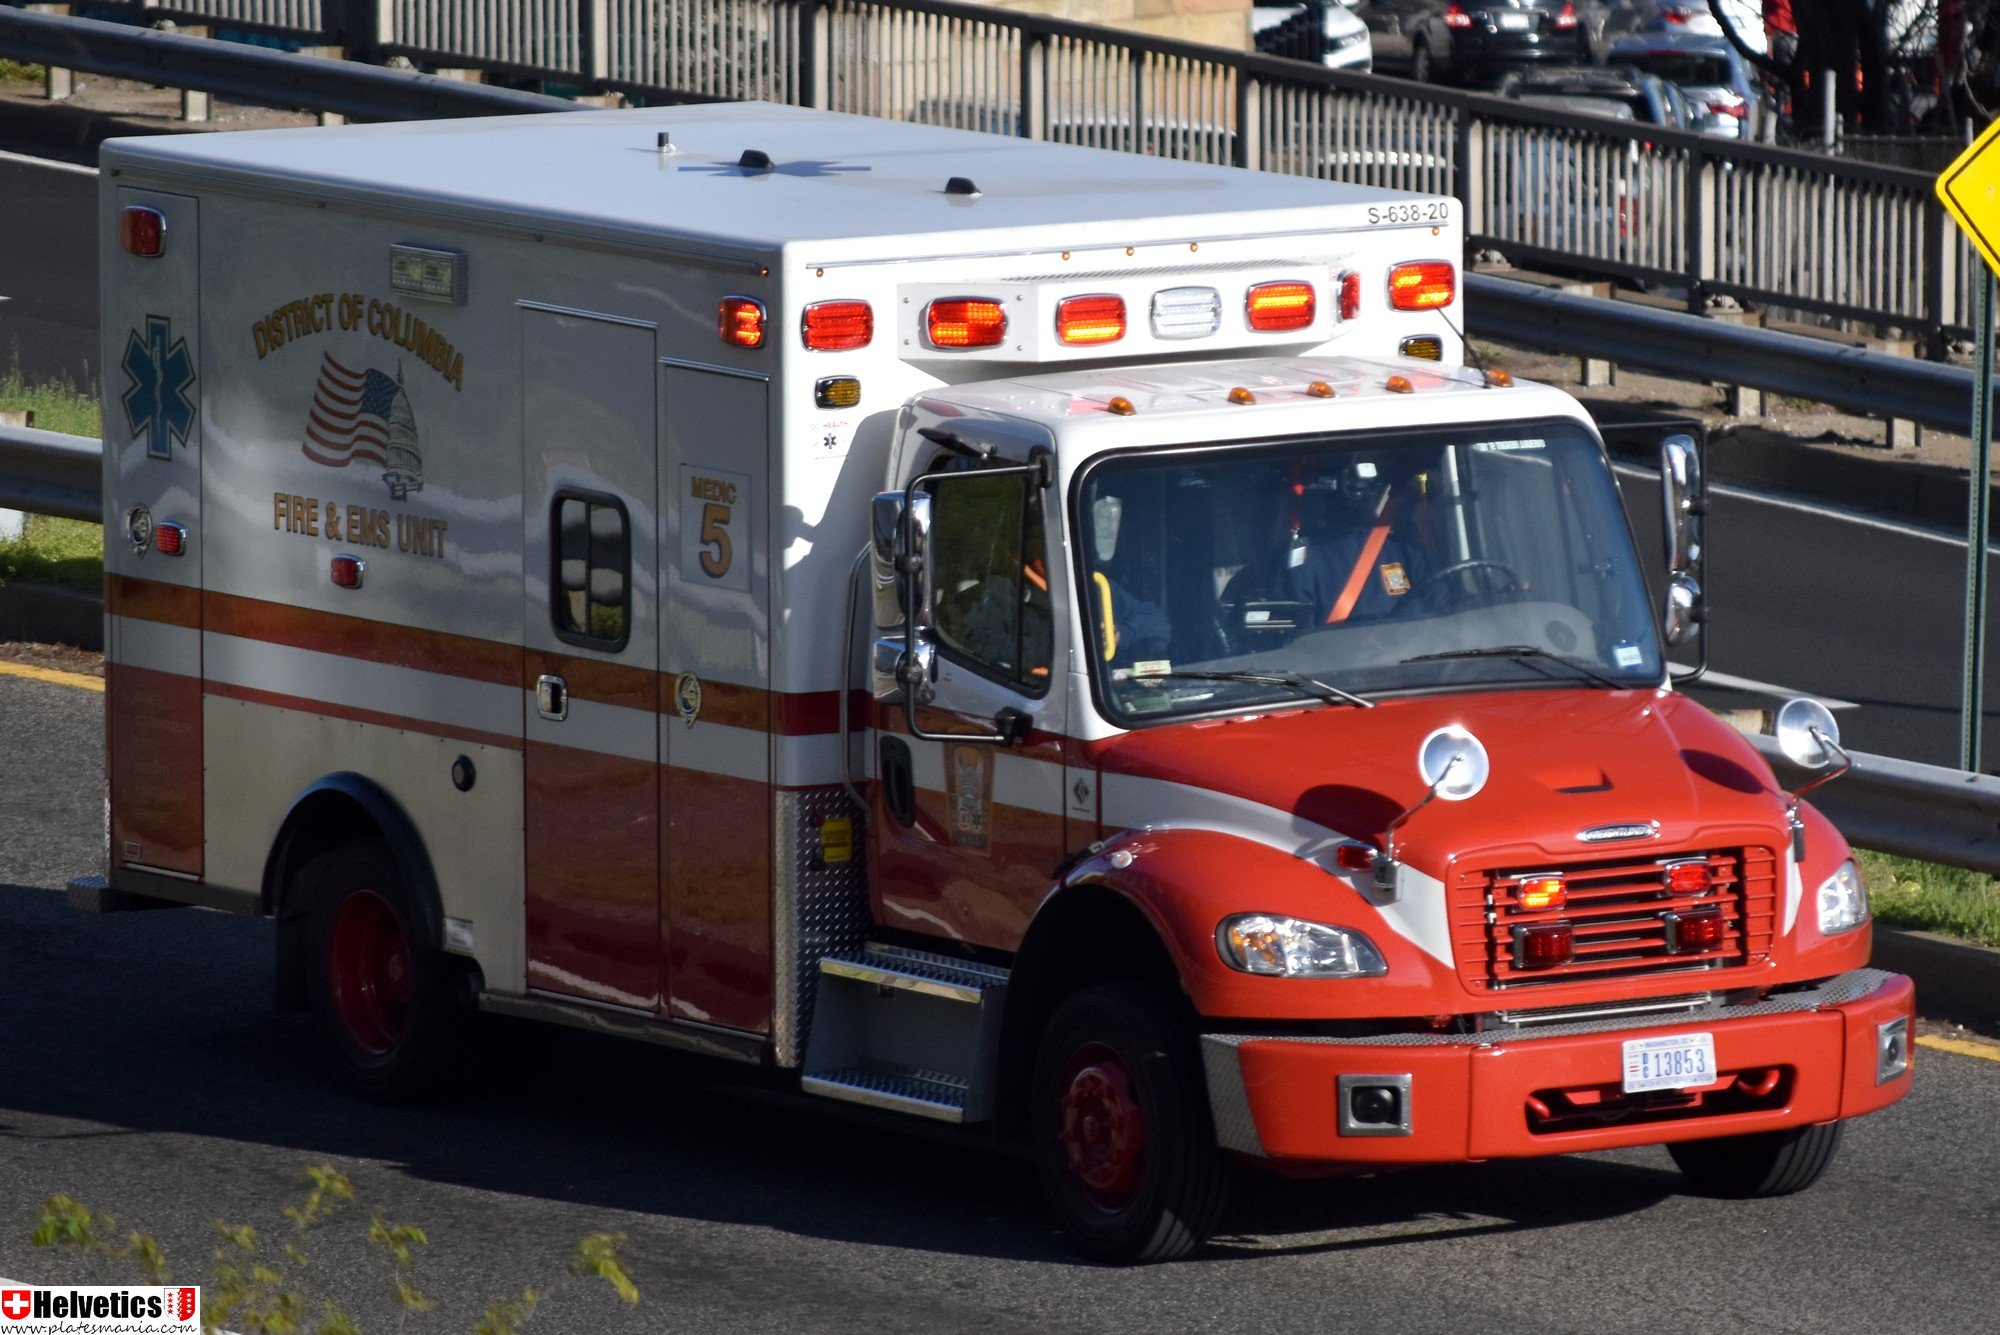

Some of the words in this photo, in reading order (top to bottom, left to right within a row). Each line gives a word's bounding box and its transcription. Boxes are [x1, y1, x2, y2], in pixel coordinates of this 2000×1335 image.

[1368, 202, 1449, 224] S-638-20
[252, 293, 334, 360] DISTRICT
[339, 293, 365, 331] OF
[368, 299, 464, 392] COLUMBIA
[691, 476, 737, 505] MEDIC
[274, 492, 318, 537] FIRE
[325, 502, 342, 541] &
[347, 505, 391, 549] EMS
[397, 513, 448, 558] UNIT
[699, 503, 732, 579] 5
[1654, 1048, 1706, 1078] 13853
